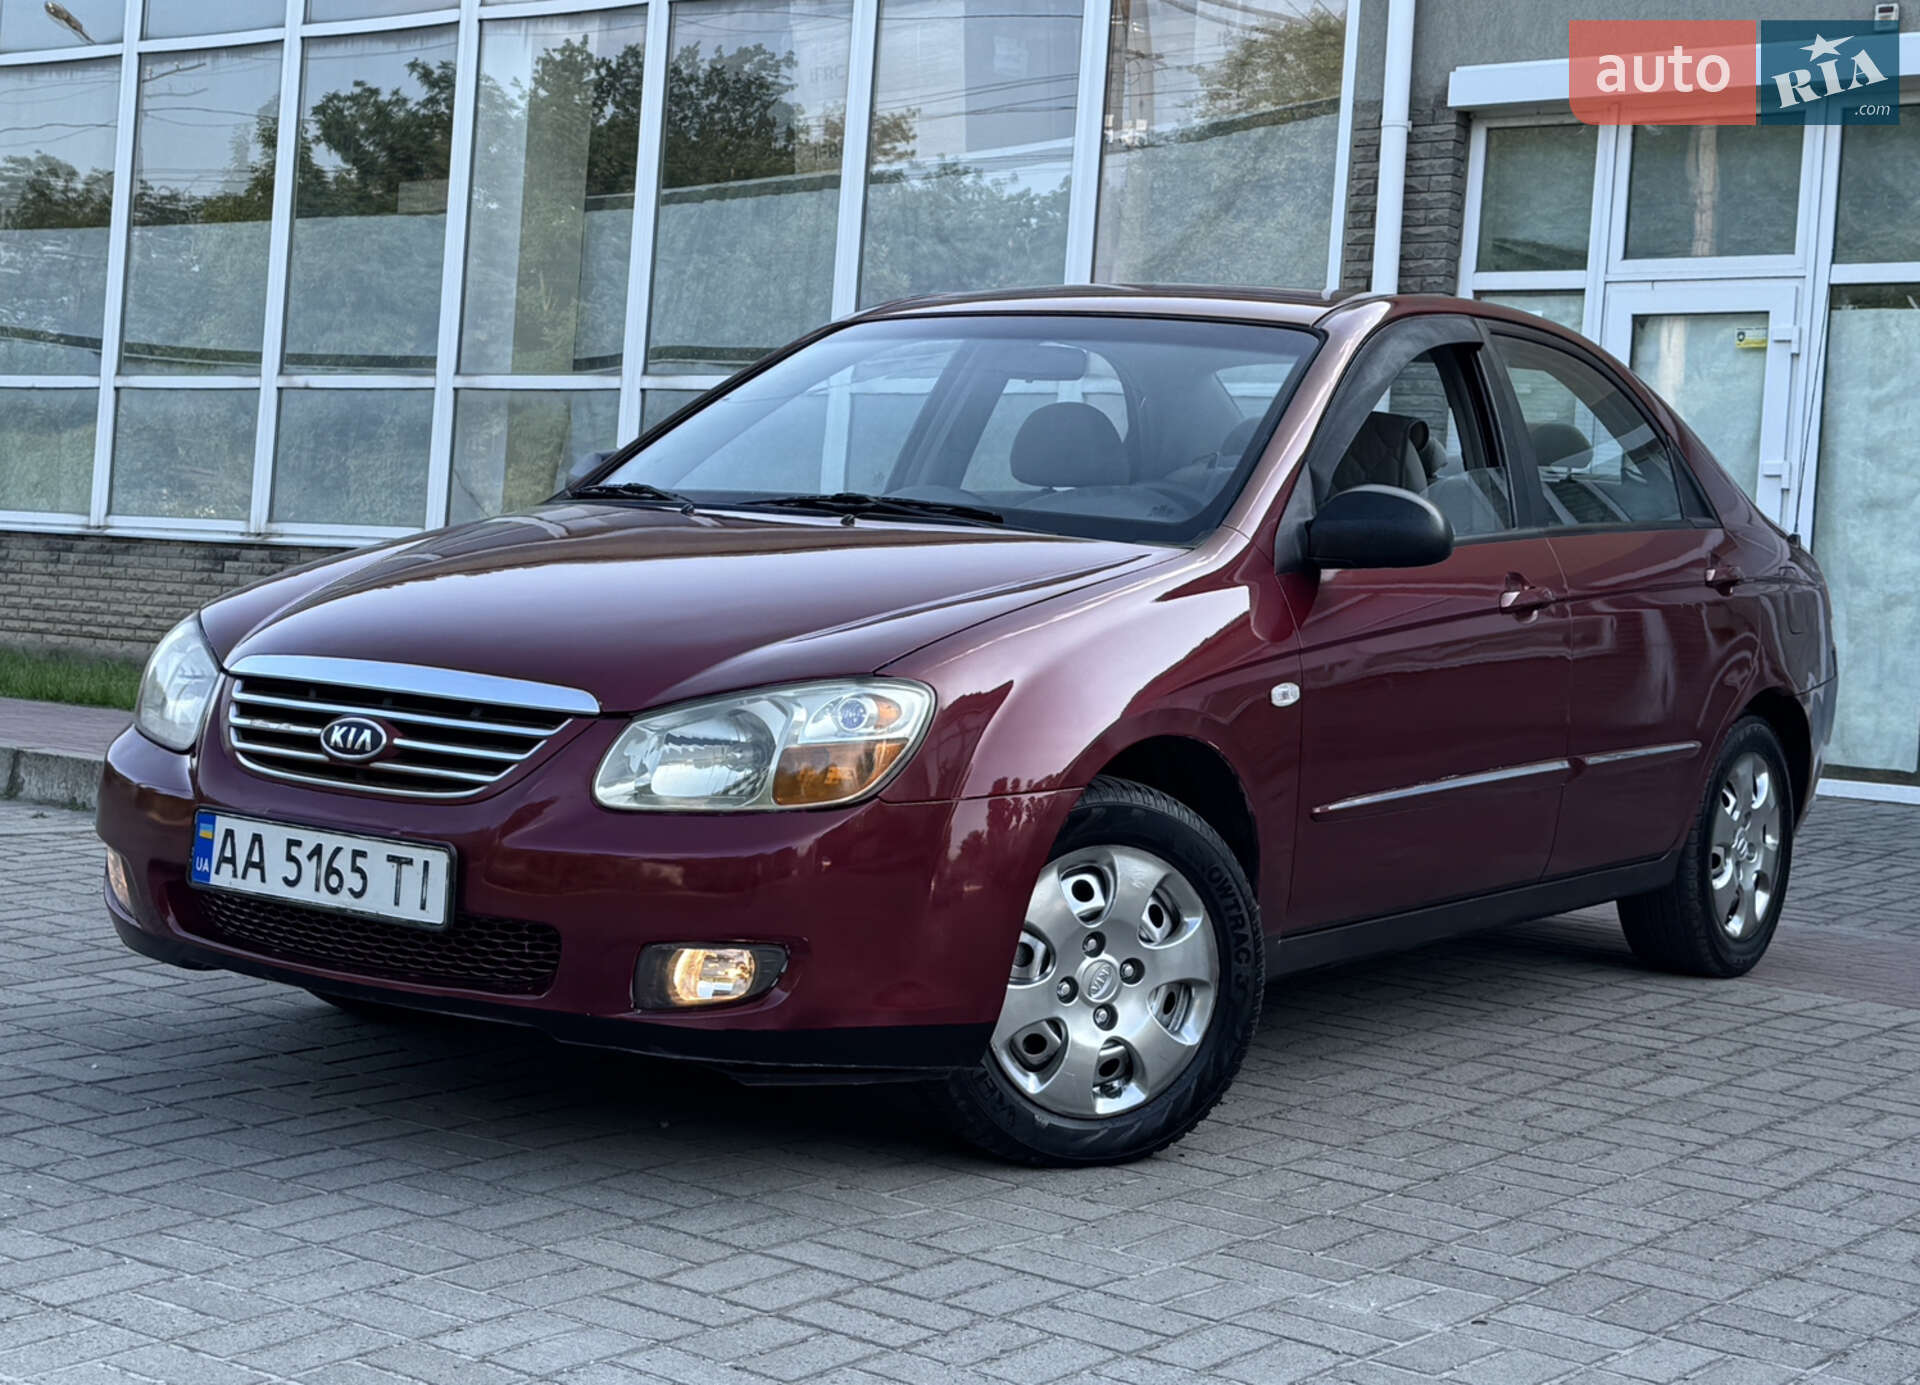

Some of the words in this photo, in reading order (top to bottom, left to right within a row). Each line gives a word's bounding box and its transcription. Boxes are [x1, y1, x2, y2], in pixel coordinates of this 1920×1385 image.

[330, 725, 372, 752] KIA
[195, 856, 210, 874] UA
[214, 828, 266, 884] AA
[282, 838, 369, 899] 5165
[386, 854, 430, 911] TI
